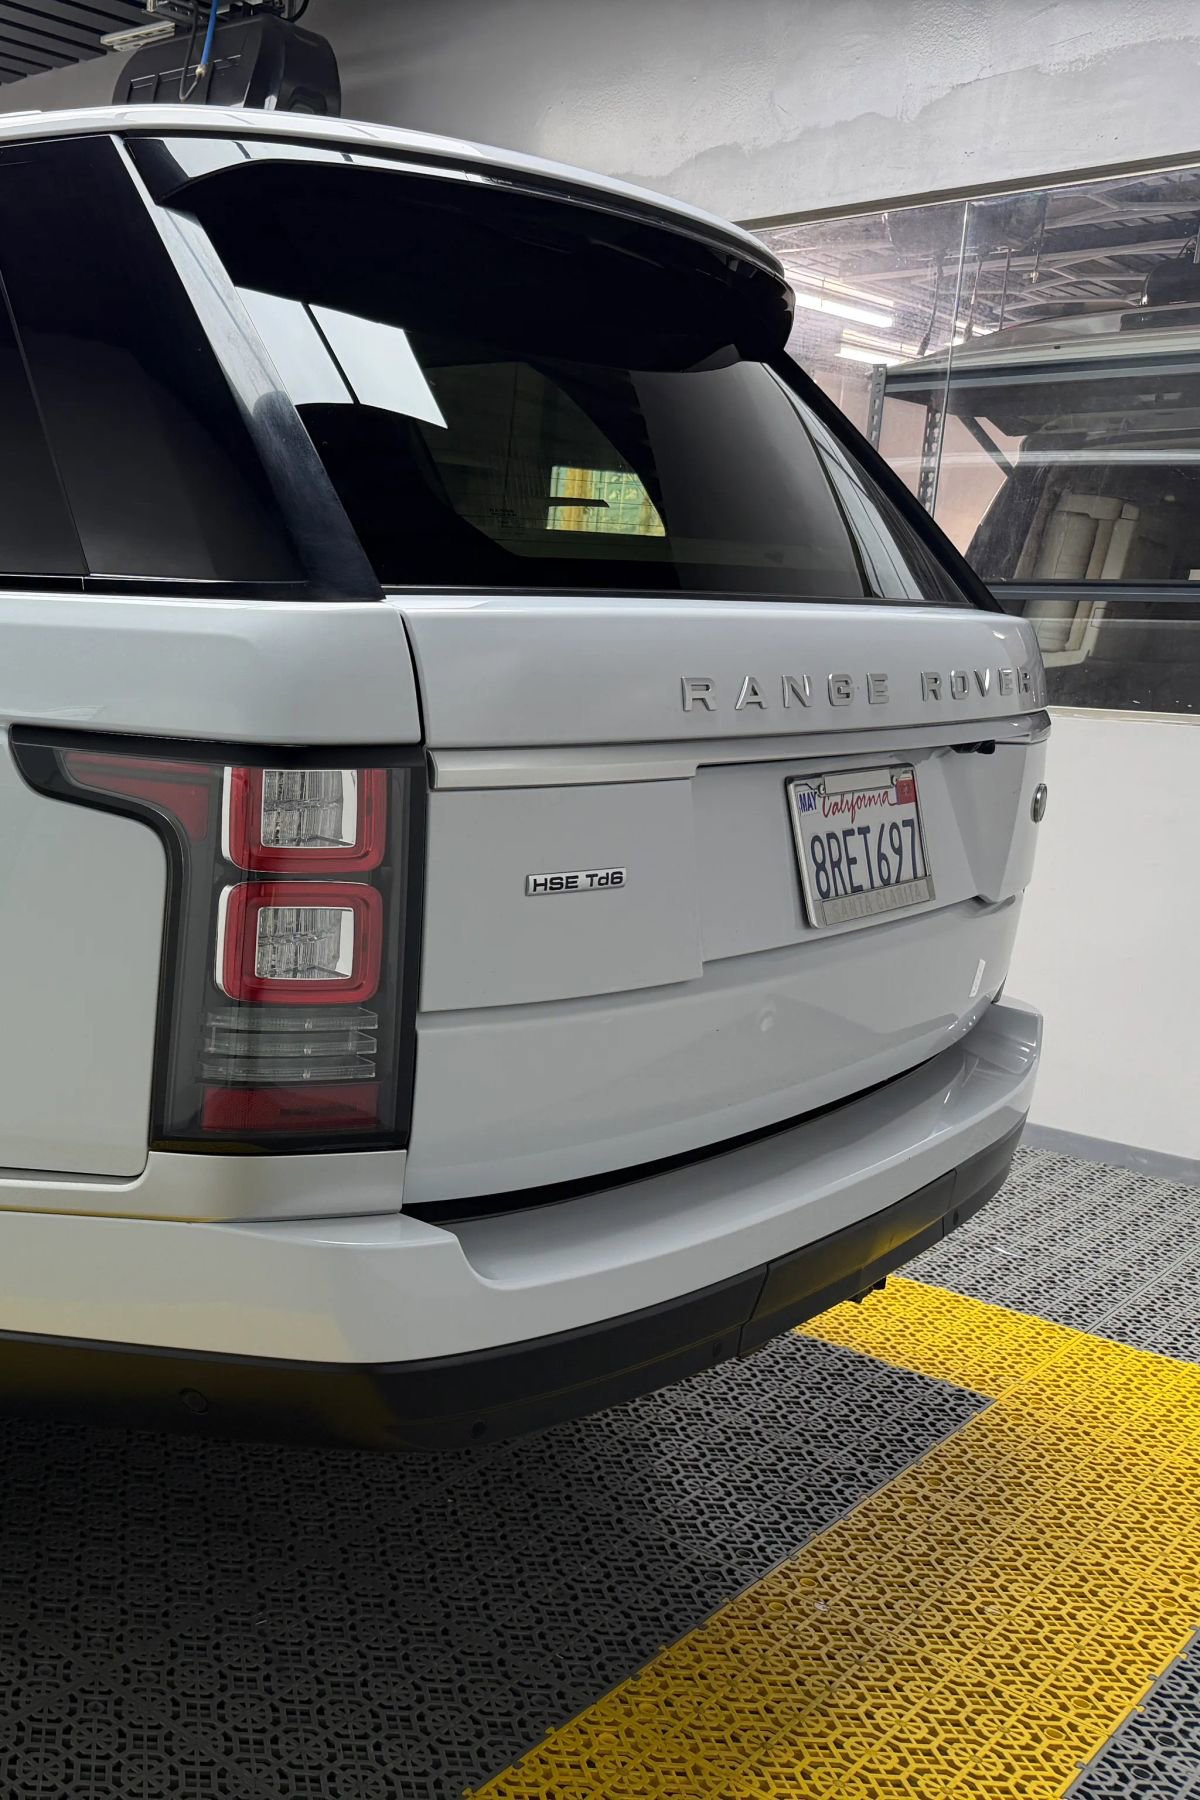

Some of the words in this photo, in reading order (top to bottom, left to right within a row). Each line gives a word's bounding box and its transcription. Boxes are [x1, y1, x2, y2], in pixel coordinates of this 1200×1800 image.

[680, 672, 890, 712] RANGE
[920, 666, 1031, 702] ROVER
[799, 791, 817, 813] MAY
[821, 790, 898, 824] California
[810, 818, 918, 899] 8RET697
[533, 875, 579, 892] HSE
[585, 871, 624, 887] Td6
